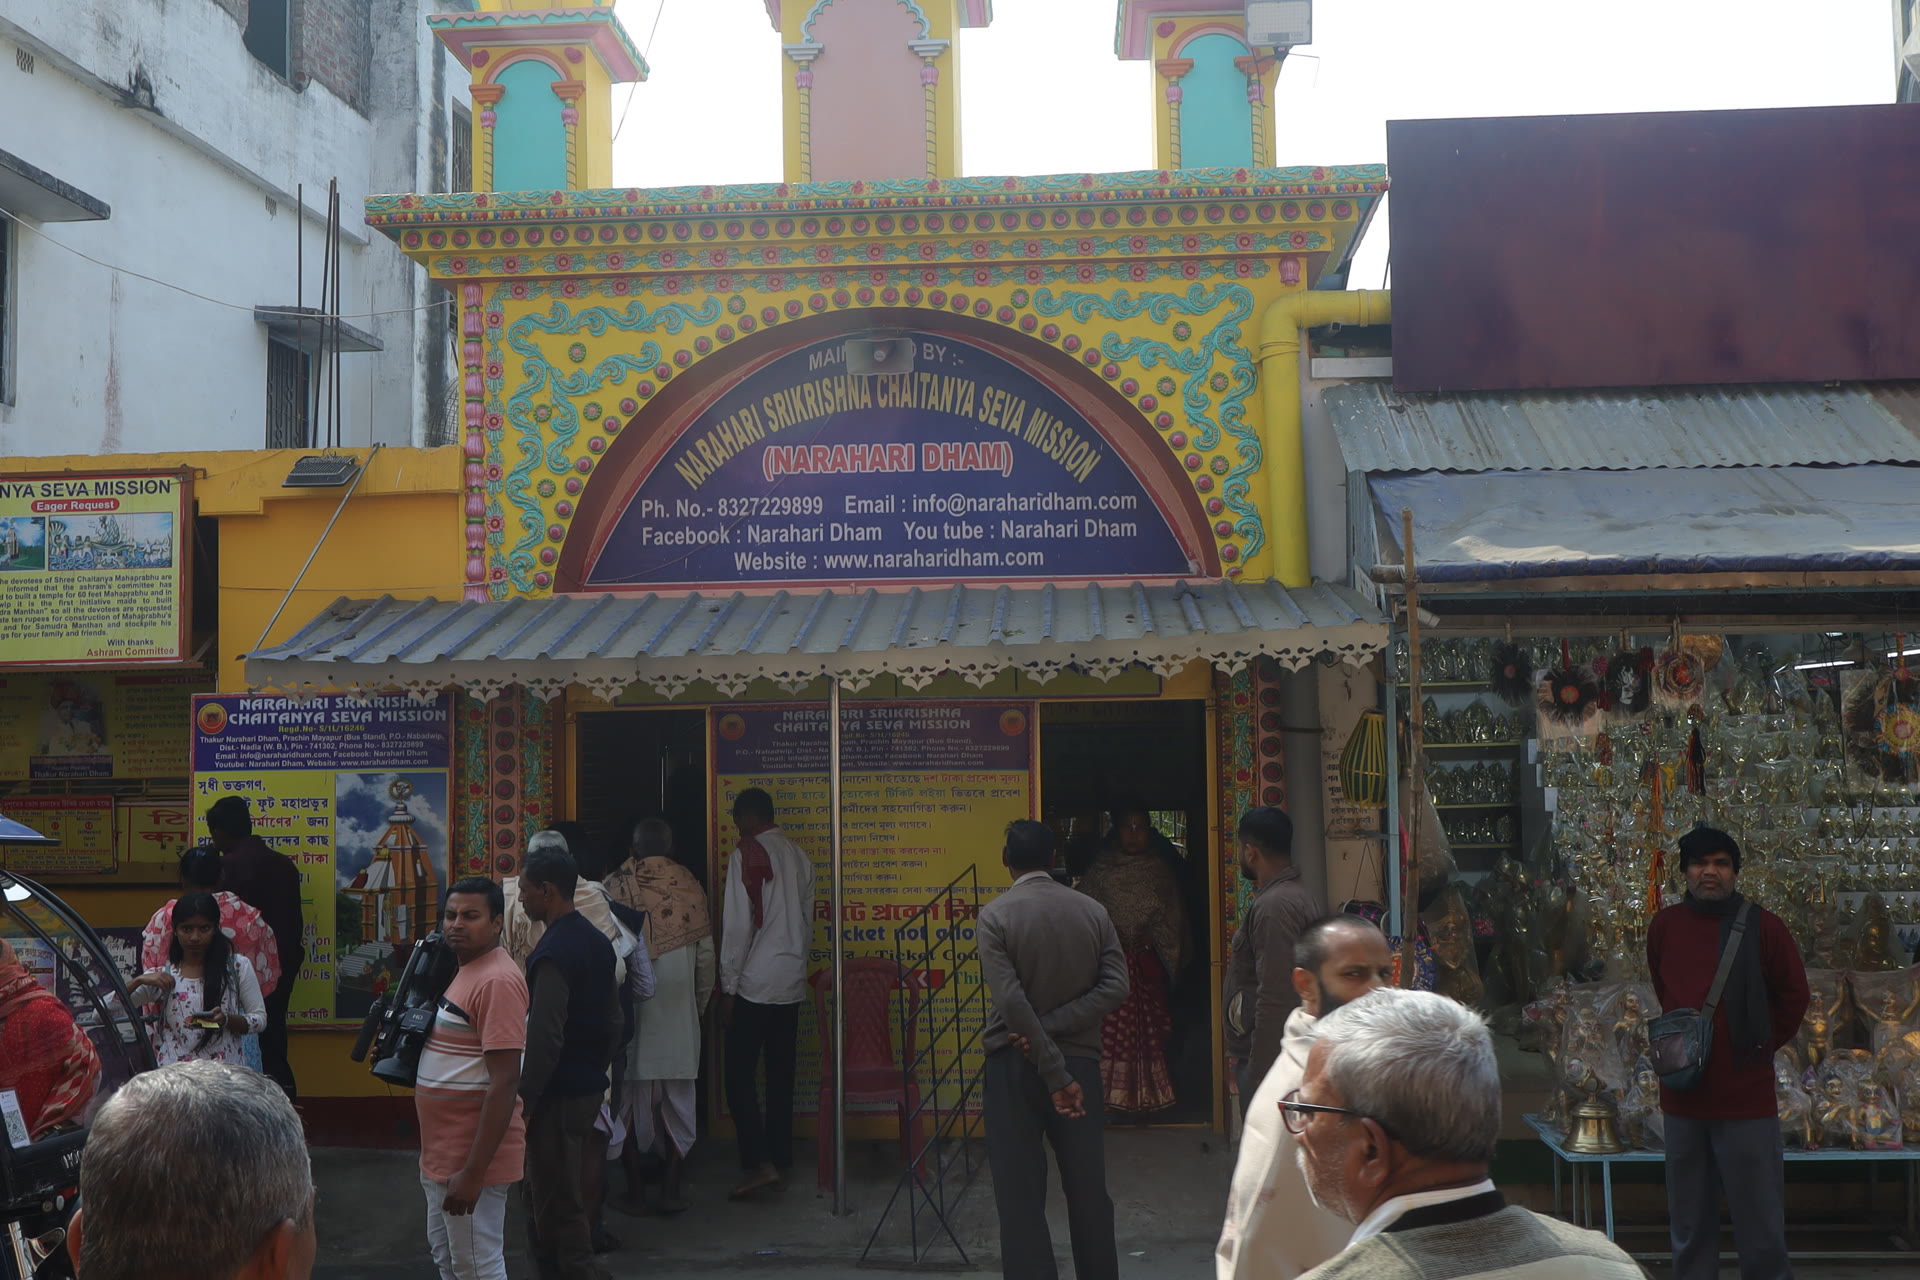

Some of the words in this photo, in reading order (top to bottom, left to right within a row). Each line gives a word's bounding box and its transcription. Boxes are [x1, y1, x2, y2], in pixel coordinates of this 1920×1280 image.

[923, 344, 947, 363] BY
[674, 403, 766, 491] NARAHARI
[762, 374, 871, 433] SRIKRISHNA
[876, 372, 975, 418] CHAITANYA
[978, 386, 1027, 437] SEVA
[1023, 408, 1102, 484] MISSION
[763, 443, 916, 481] (NARAHARI
[923, 441, 1013, 477] DHAM)
[41, 481, 89, 497] SEVA
[94, 479, 171, 496] MISSION
[36, 501, 68, 512] Eager
[70, 500, 115, 511] Request
[641, 499, 669, 518] Ph.
[676, 499, 712, 517] No.-
[718, 496, 824, 516] 8327229899
[844, 494, 895, 514] Email
[913, 492, 1137, 517] info@naraharidham.com
[642, 525, 730, 546] Facebook
[747, 523, 824, 543] Narahari
[830, 523, 882, 542] Dham
[903, 521, 937, 540] You
[943, 521, 984, 539] tube
[1001, 519, 1078, 538] Narahari
[1085, 518, 1137, 537] Dham
[734, 552, 807, 570] Website
[824, 548, 1044, 569] www.naraharidham.com
[240, 697, 329, 711] NARAHARI
[229, 712, 324, 726] CHAITANYA
[331, 711, 372, 723] SEVA
[379, 710, 446, 722] MISSION
[783, 709, 863, 721] NARAARI
[870, 708, 961, 719] SRIKRISHNA
[278, 725, 316, 733] Regd.No-
[774, 720, 860, 733] CHAITAYA
[866, 720, 904, 730] SEVA
[909, 719, 970, 729] MISSION
[240, 751, 331, 760] info@naraharidham.com,
[951, 786, 985, 798] ভিতরে
[990, 789, 1020, 798] প্রবেশ
[256, 796, 275, 812] ফুট
[280, 797, 328, 812] মহাপ্রভুর
[306, 816, 329, 828] জন্য
[303, 851, 328, 864] টাকা
[823, 926, 886, 942] Tcket
